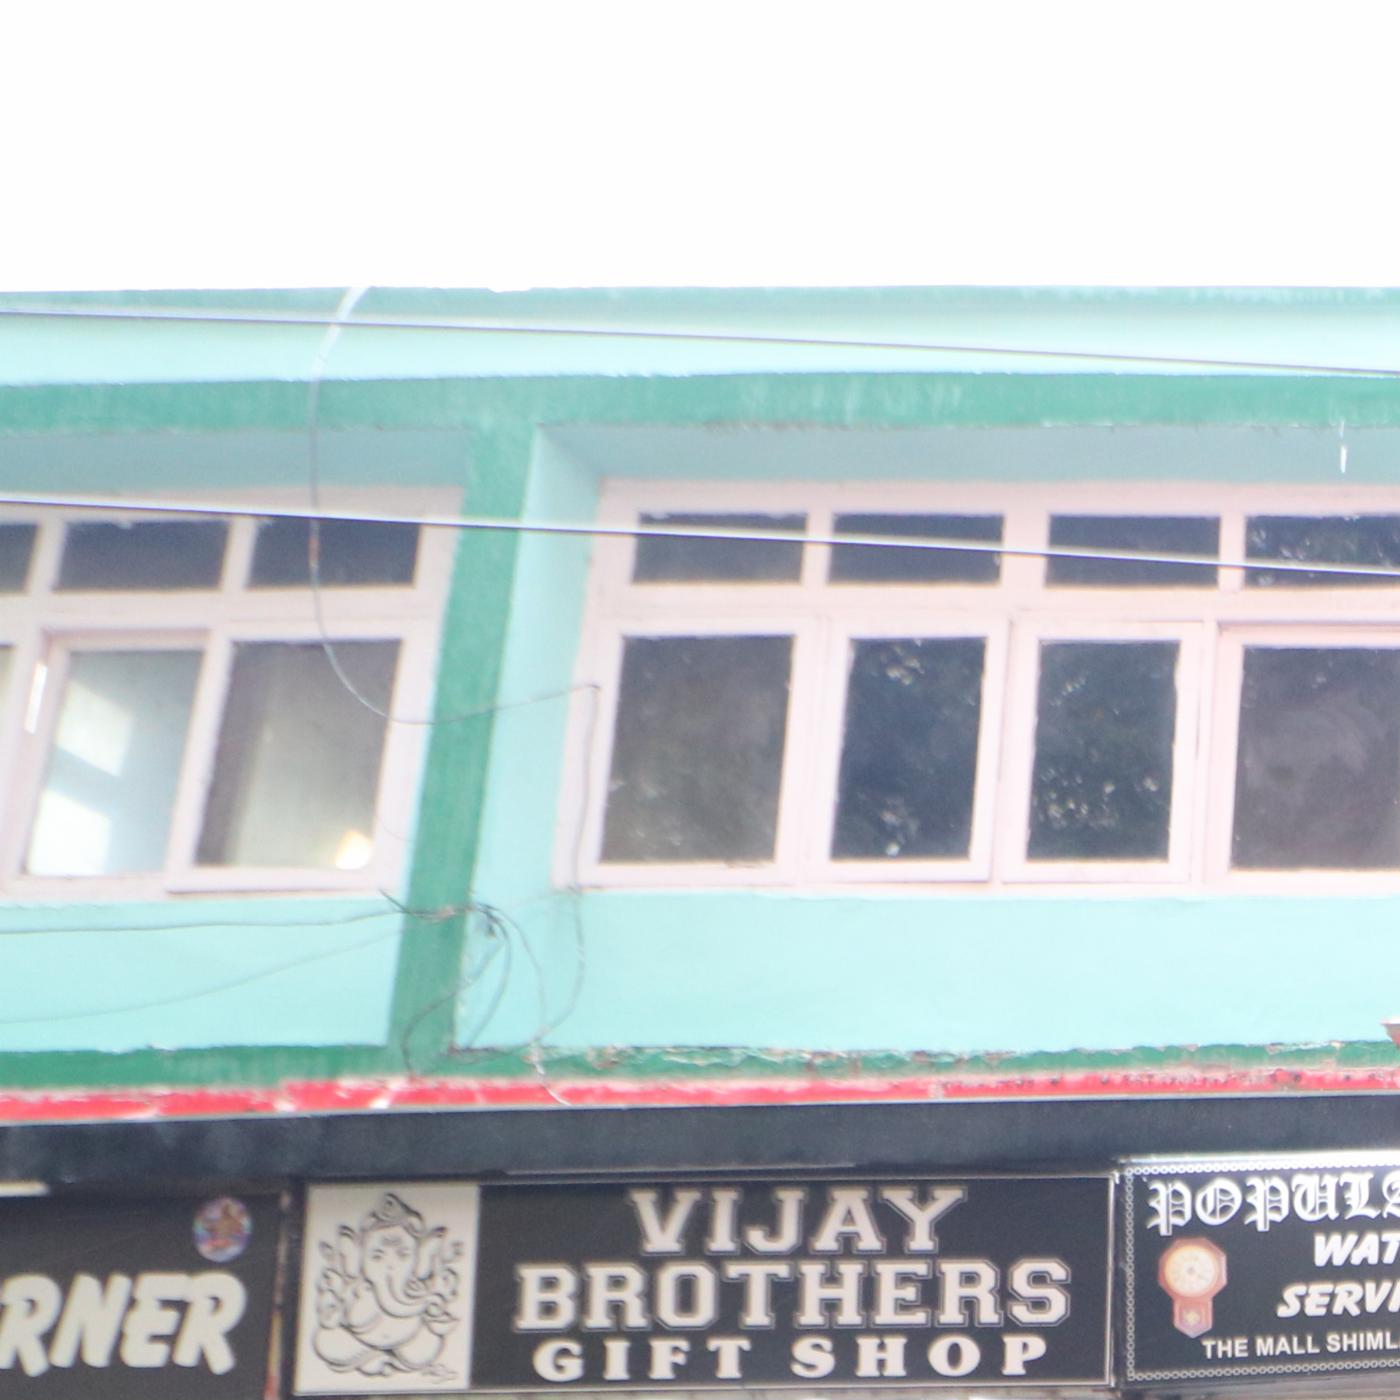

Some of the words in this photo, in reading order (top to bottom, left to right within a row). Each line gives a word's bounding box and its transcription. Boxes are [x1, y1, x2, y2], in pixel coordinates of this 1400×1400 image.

[627, 1185, 969, 1257] VIJAY
[513, 1257, 1072, 1333] BROTHERS
[532, 1337, 751, 1383] GIFT
[790, 1334, 1048, 1379] SHOP
[1202, 1339, 1249, 1360] THE
[1256, 1335, 1320, 1358] MALL
